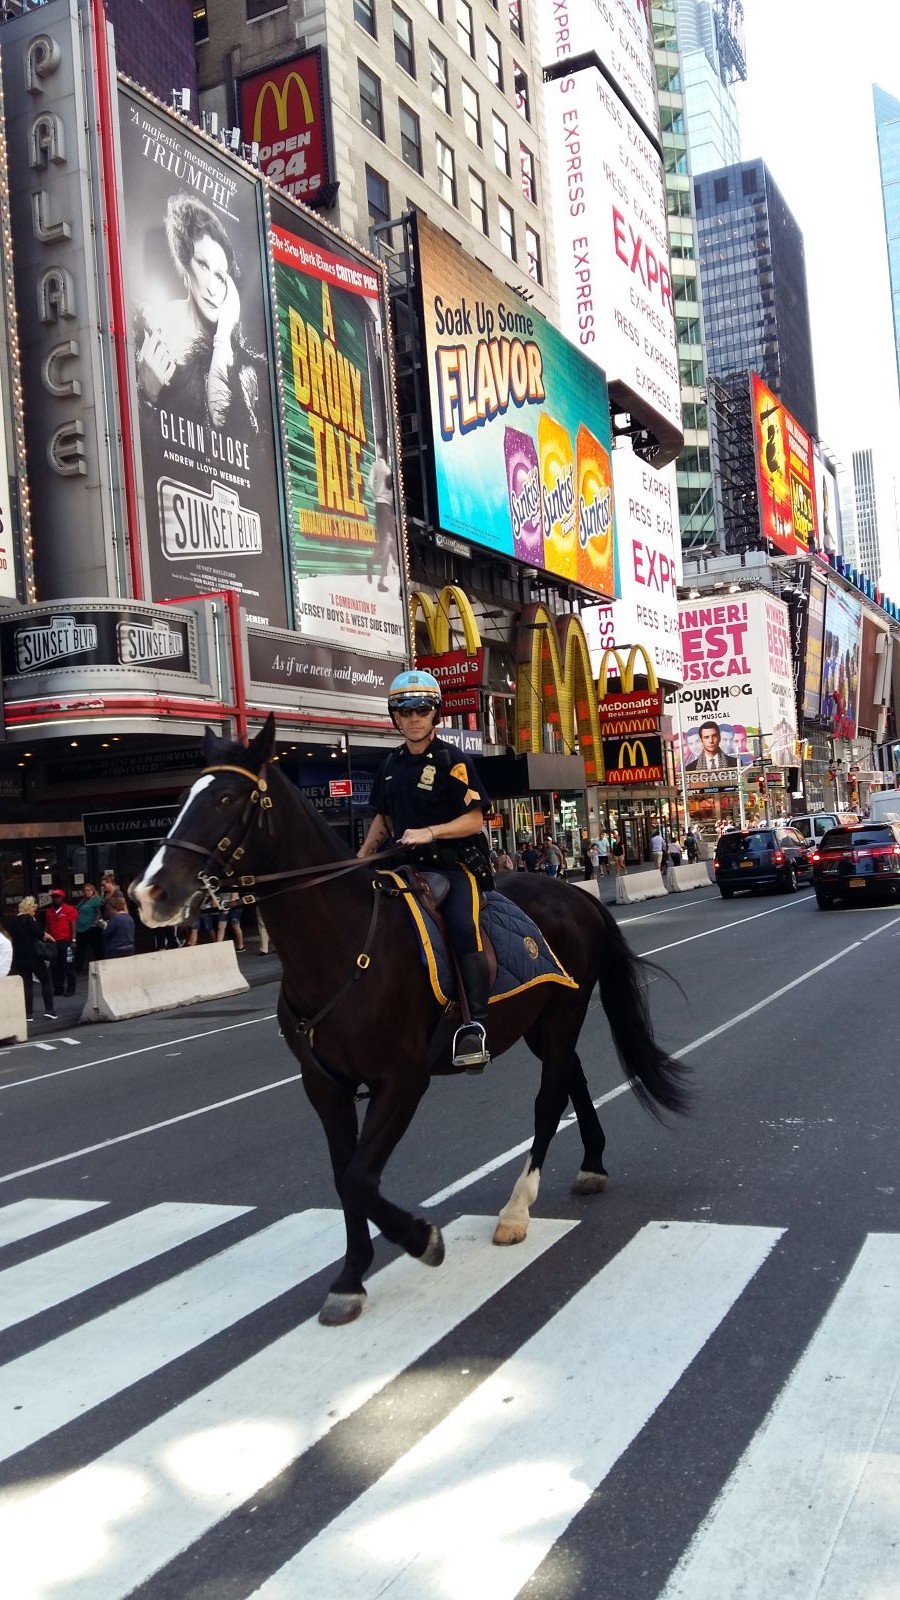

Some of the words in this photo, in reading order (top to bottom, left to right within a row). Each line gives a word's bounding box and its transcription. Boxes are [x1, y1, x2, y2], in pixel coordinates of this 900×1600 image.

[259, 131, 311, 161] OPEN
[562, 109, 586, 217] EXPRESS
[184, 149, 237, 192] mesmerizing
[266, 151, 307, 183] 24
[24, 33, 87, 477] PALACE
[283, 238, 299, 257] New
[299, 246, 317, 266] York
[315, 252, 336, 275] Times
[363, 274, 379, 291] PICK
[572, 236, 596, 345] EXPRESS
[321, 279, 337, 345] A
[434, 295, 473, 336] Soak
[475, 301, 495, 341] Up
[498, 302, 534, 336] Some
[630, 286, 667, 339] EXPRESS
[288, 304, 368, 445] BRONX
[644, 336, 679, 385] EXPRESS
[435, 336, 545, 441] FLAVOR
[635, 366, 672, 413] EXPRESS
[160, 409, 205, 454] GLENN
[211, 430, 250, 471] CLOSE
[163, 450, 195, 468] ANDREW
[196, 461, 218, 476] LLOYD
[220, 470, 251, 488] WEBBER'S
[308, 410, 367, 519] TALE
[172, 493, 234, 549] SUNSET
[237, 513, 261, 549] BLVD.
[512, 472, 540, 537] Sunkist
[542, 466, 575, 538] Sunkist
[580, 494, 611, 547] Sunkist
[300, 602, 325, 620] JERSEY
[326, 608, 345, 624] BOYS
[345, 612, 350, 625] &
[351, 613, 368, 629] WEST
[369, 618, 383, 632] SIDE
[335, 594, 370, 614] COMBINATION
[370, 603, 377, 616] OF
[678, 602, 748, 630] INNER!
[23, 629, 69, 666] SUNSET
[73, 628, 96, 650] BLVD.
[128, 628, 167, 659] SUNSET
[681, 622, 748, 662] EST
[766, 620, 789, 660] BEST
[272, 654, 285, 671] As
[286, 657, 295, 676] if
[295, 661, 309, 674] we
[309, 664, 332, 677] never
[333, 665, 351, 680] said
[351, 669, 385, 689] goodbye.
[445, 697, 475, 708] HOURS
[597, 697, 659, 713] McDonald's
[608, 708, 649, 718] Restaurant
[694, 700, 720, 714] DAY
[702, 712, 731, 721] MUSICAL
[465, 736, 483, 751] ATM
[302, 786, 326, 797] NEY
